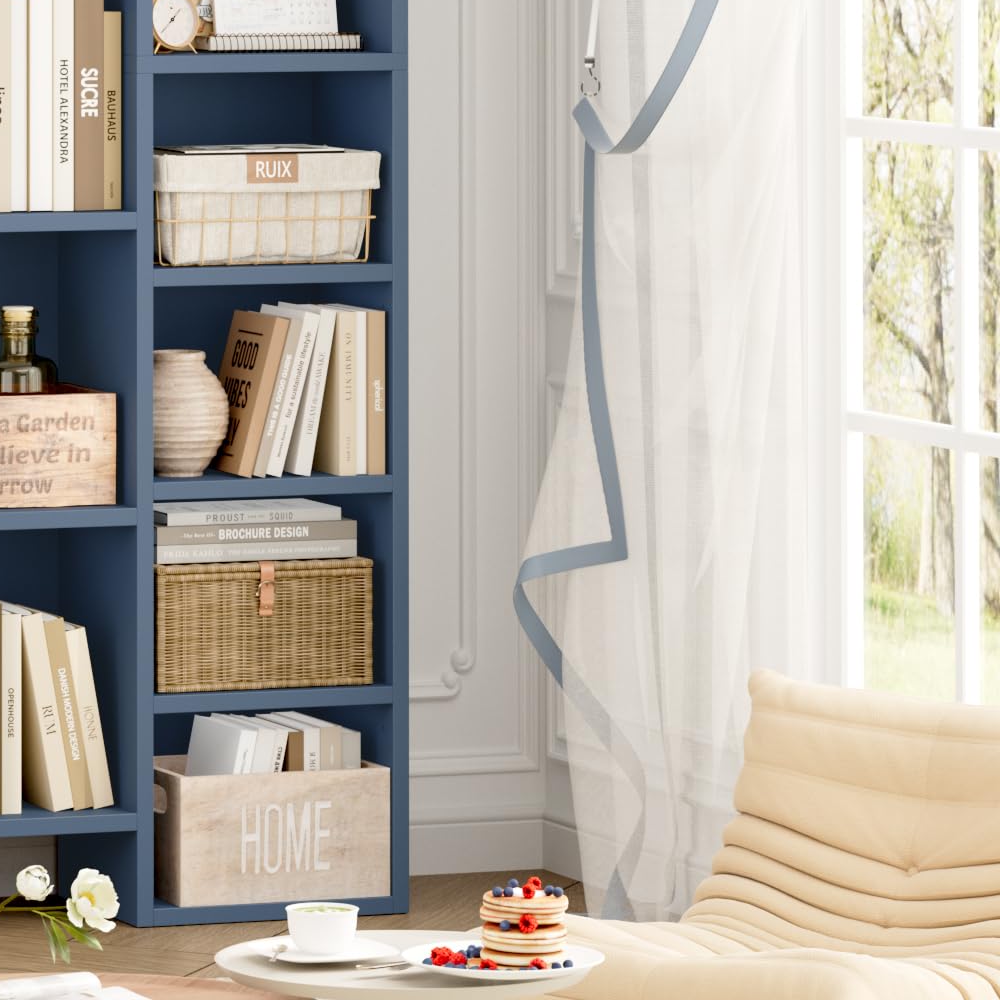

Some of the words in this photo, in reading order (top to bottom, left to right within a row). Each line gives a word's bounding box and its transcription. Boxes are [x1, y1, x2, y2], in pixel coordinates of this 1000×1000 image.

[59, 59, 69, 94] HOTEL
[80, 68, 99, 117] SUCRE
[59, 97, 69, 164] ALEXANDRA
[107, 90, 117, 141] BAUHAUS
[255, 160, 292, 178] RUIX
[231, 339, 259, 371] GOOD
[345, 332, 353, 345] ON
[290, 361, 305, 401] sustainable
[345, 351, 353, 402] IMMUNITY
[16, 411, 95, 433] Garden
[67, 443, 91, 463] in
[205, 512, 245, 522] PROUST
[269, 512, 294, 521] SQUID
[218, 527, 271, 541] BROCHURE
[273, 525, 309, 538] DESIGN
[57, 668, 71, 697] DANISH
[7, 688, 15, 738] OPENHOUSE
[41, 704, 57, 735] RUM
[61, 697, 76, 732] MODERN
[83, 705, 98, 742] HONNE
[67, 732, 81, 760] DESIGN
[240, 800, 332, 874] HOME
